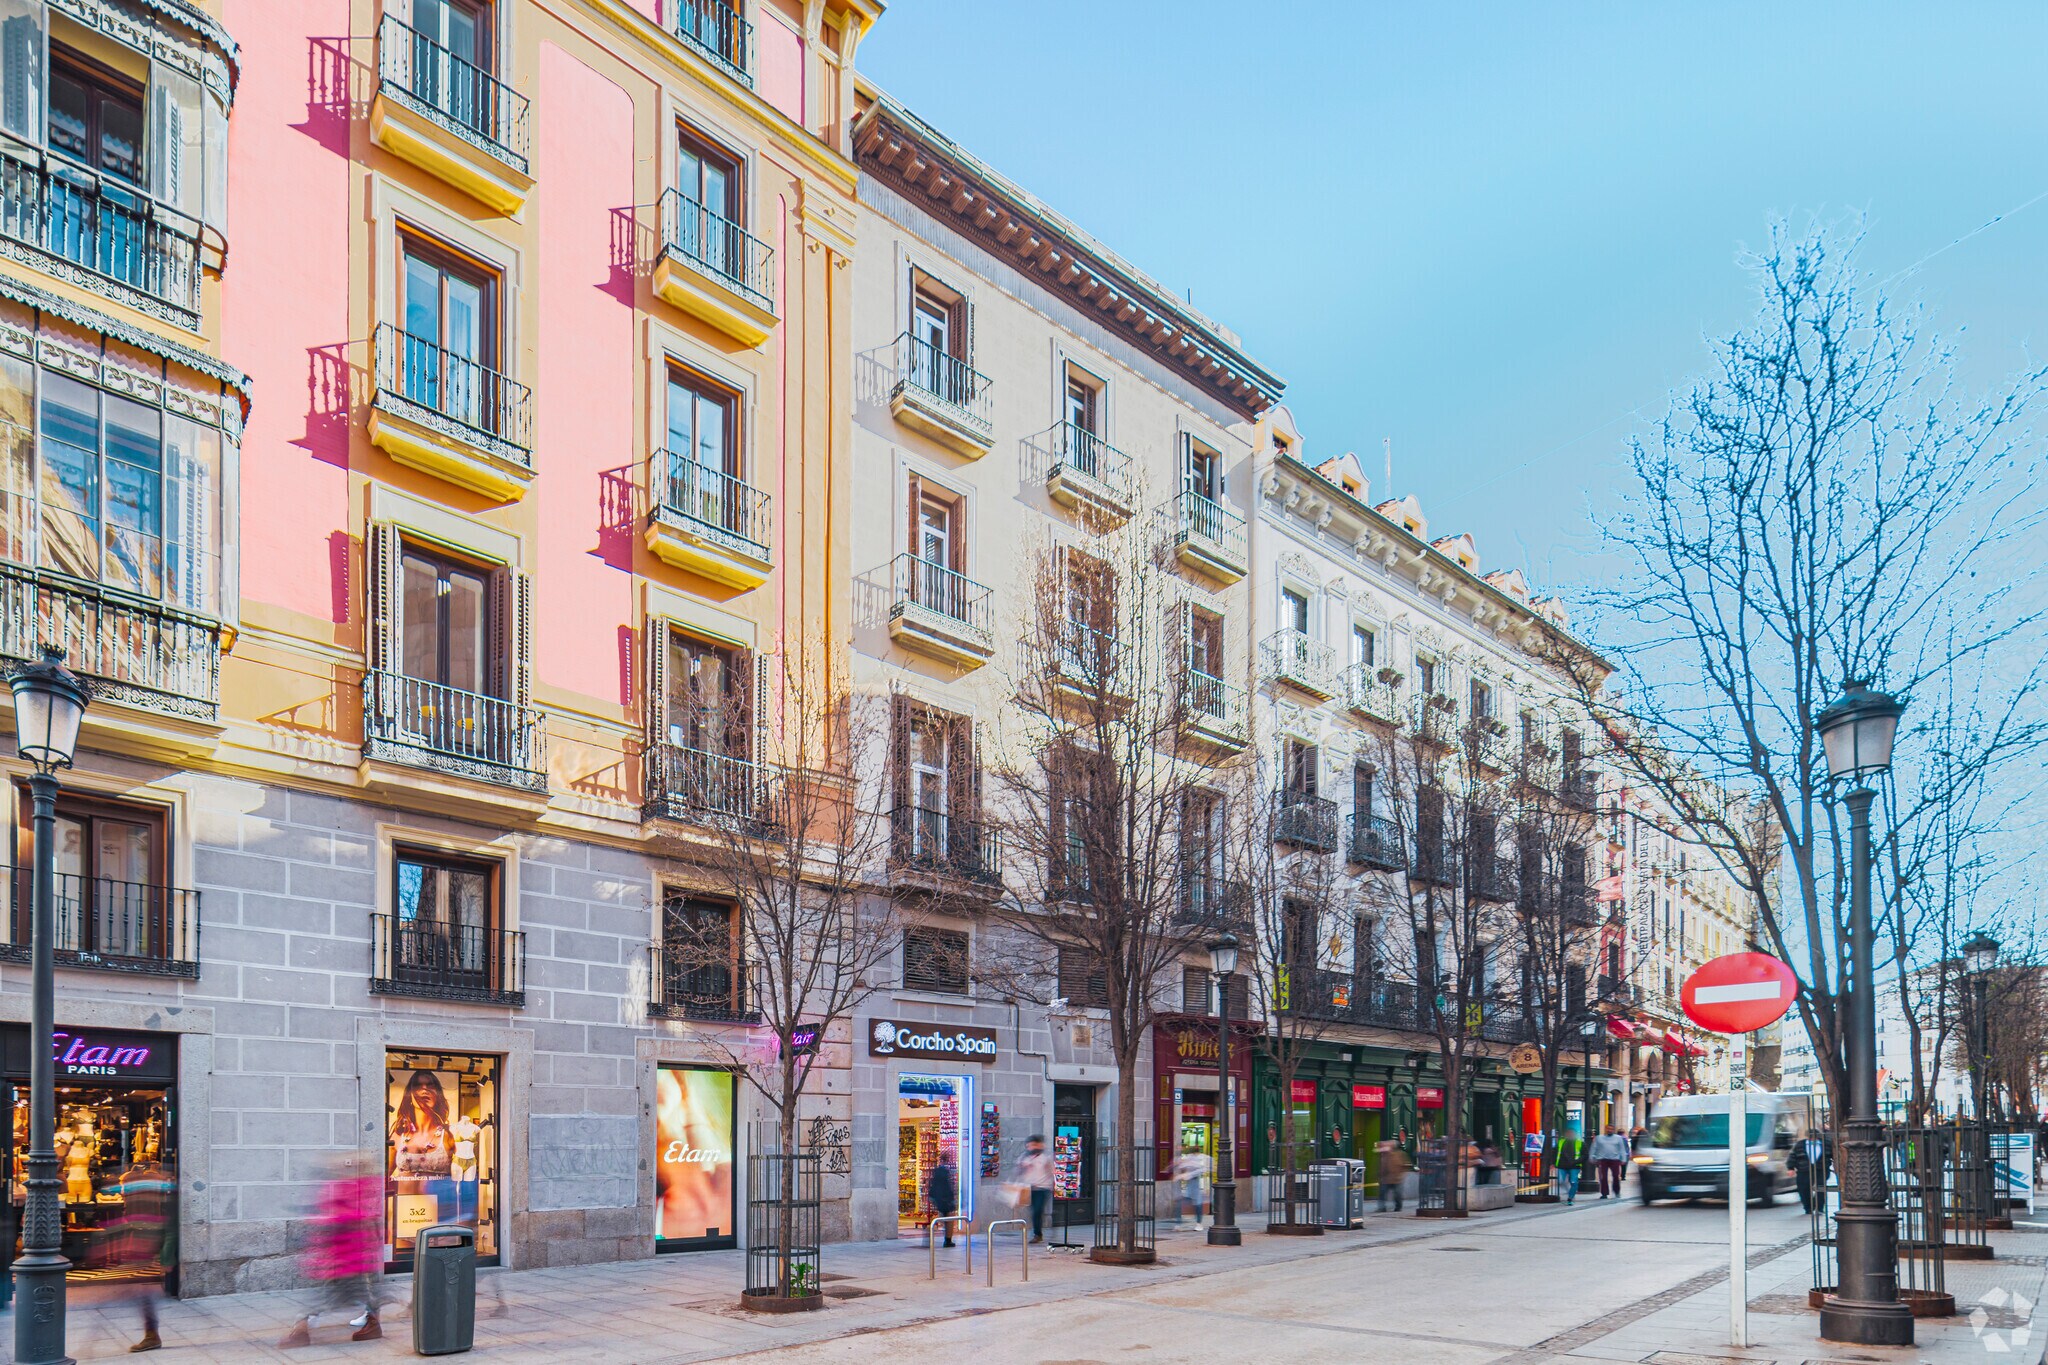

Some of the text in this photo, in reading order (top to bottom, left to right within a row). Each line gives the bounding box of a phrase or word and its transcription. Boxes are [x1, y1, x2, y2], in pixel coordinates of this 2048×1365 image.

[1639, 841, 1649, 857] DEL
[896, 1028, 996, 1055] Corcho Spain
[1524, 1053, 1532, 1061] 8
[67, 1065, 117, 1075] PARIS
[663, 1140, 721, 1163] Etam
[409, 1208, 426, 1216] 3x2
